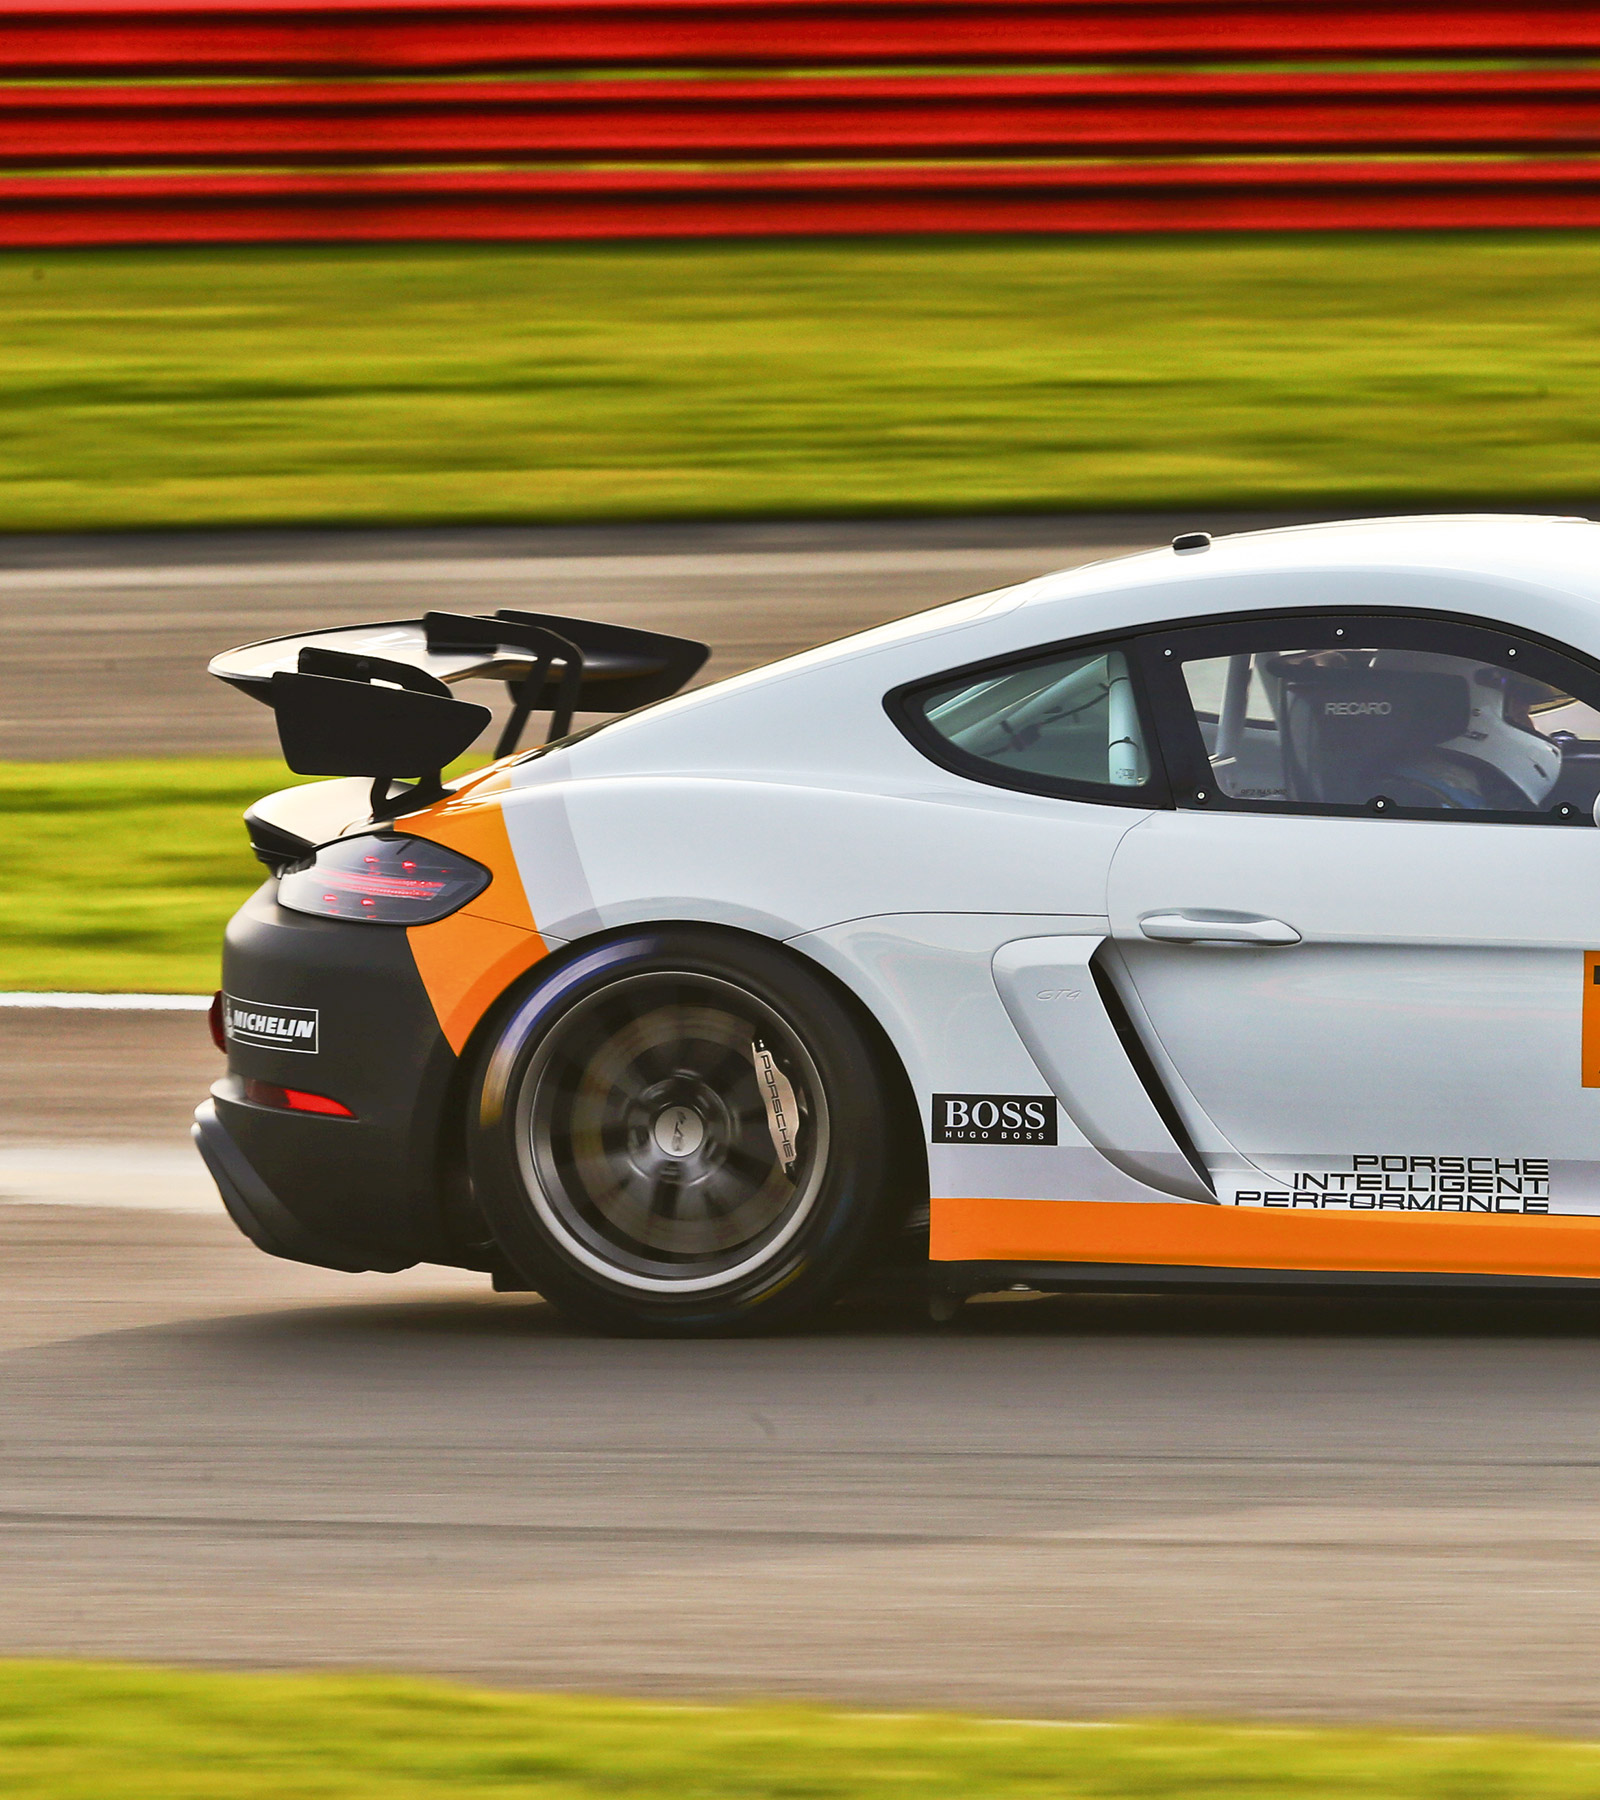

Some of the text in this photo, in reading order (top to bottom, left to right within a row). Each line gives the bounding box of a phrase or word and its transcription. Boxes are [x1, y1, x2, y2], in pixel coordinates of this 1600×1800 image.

[1325, 702, 1392, 715] RECARO
[1036, 988, 1081, 1000] GT4
[233, 1009, 315, 1038] MICHELIN
[761, 1054, 794, 1158] PORSCHE
[944, 1100, 1046, 1130] BOSS
[945, 1131, 1045, 1140] HUGO BOSS
[1353, 1154, 1548, 1175] PORSCHE
[1294, 1173, 1549, 1195] INTELLIGENT
[1235, 1191, 1548, 1213] PERFORMANCE
